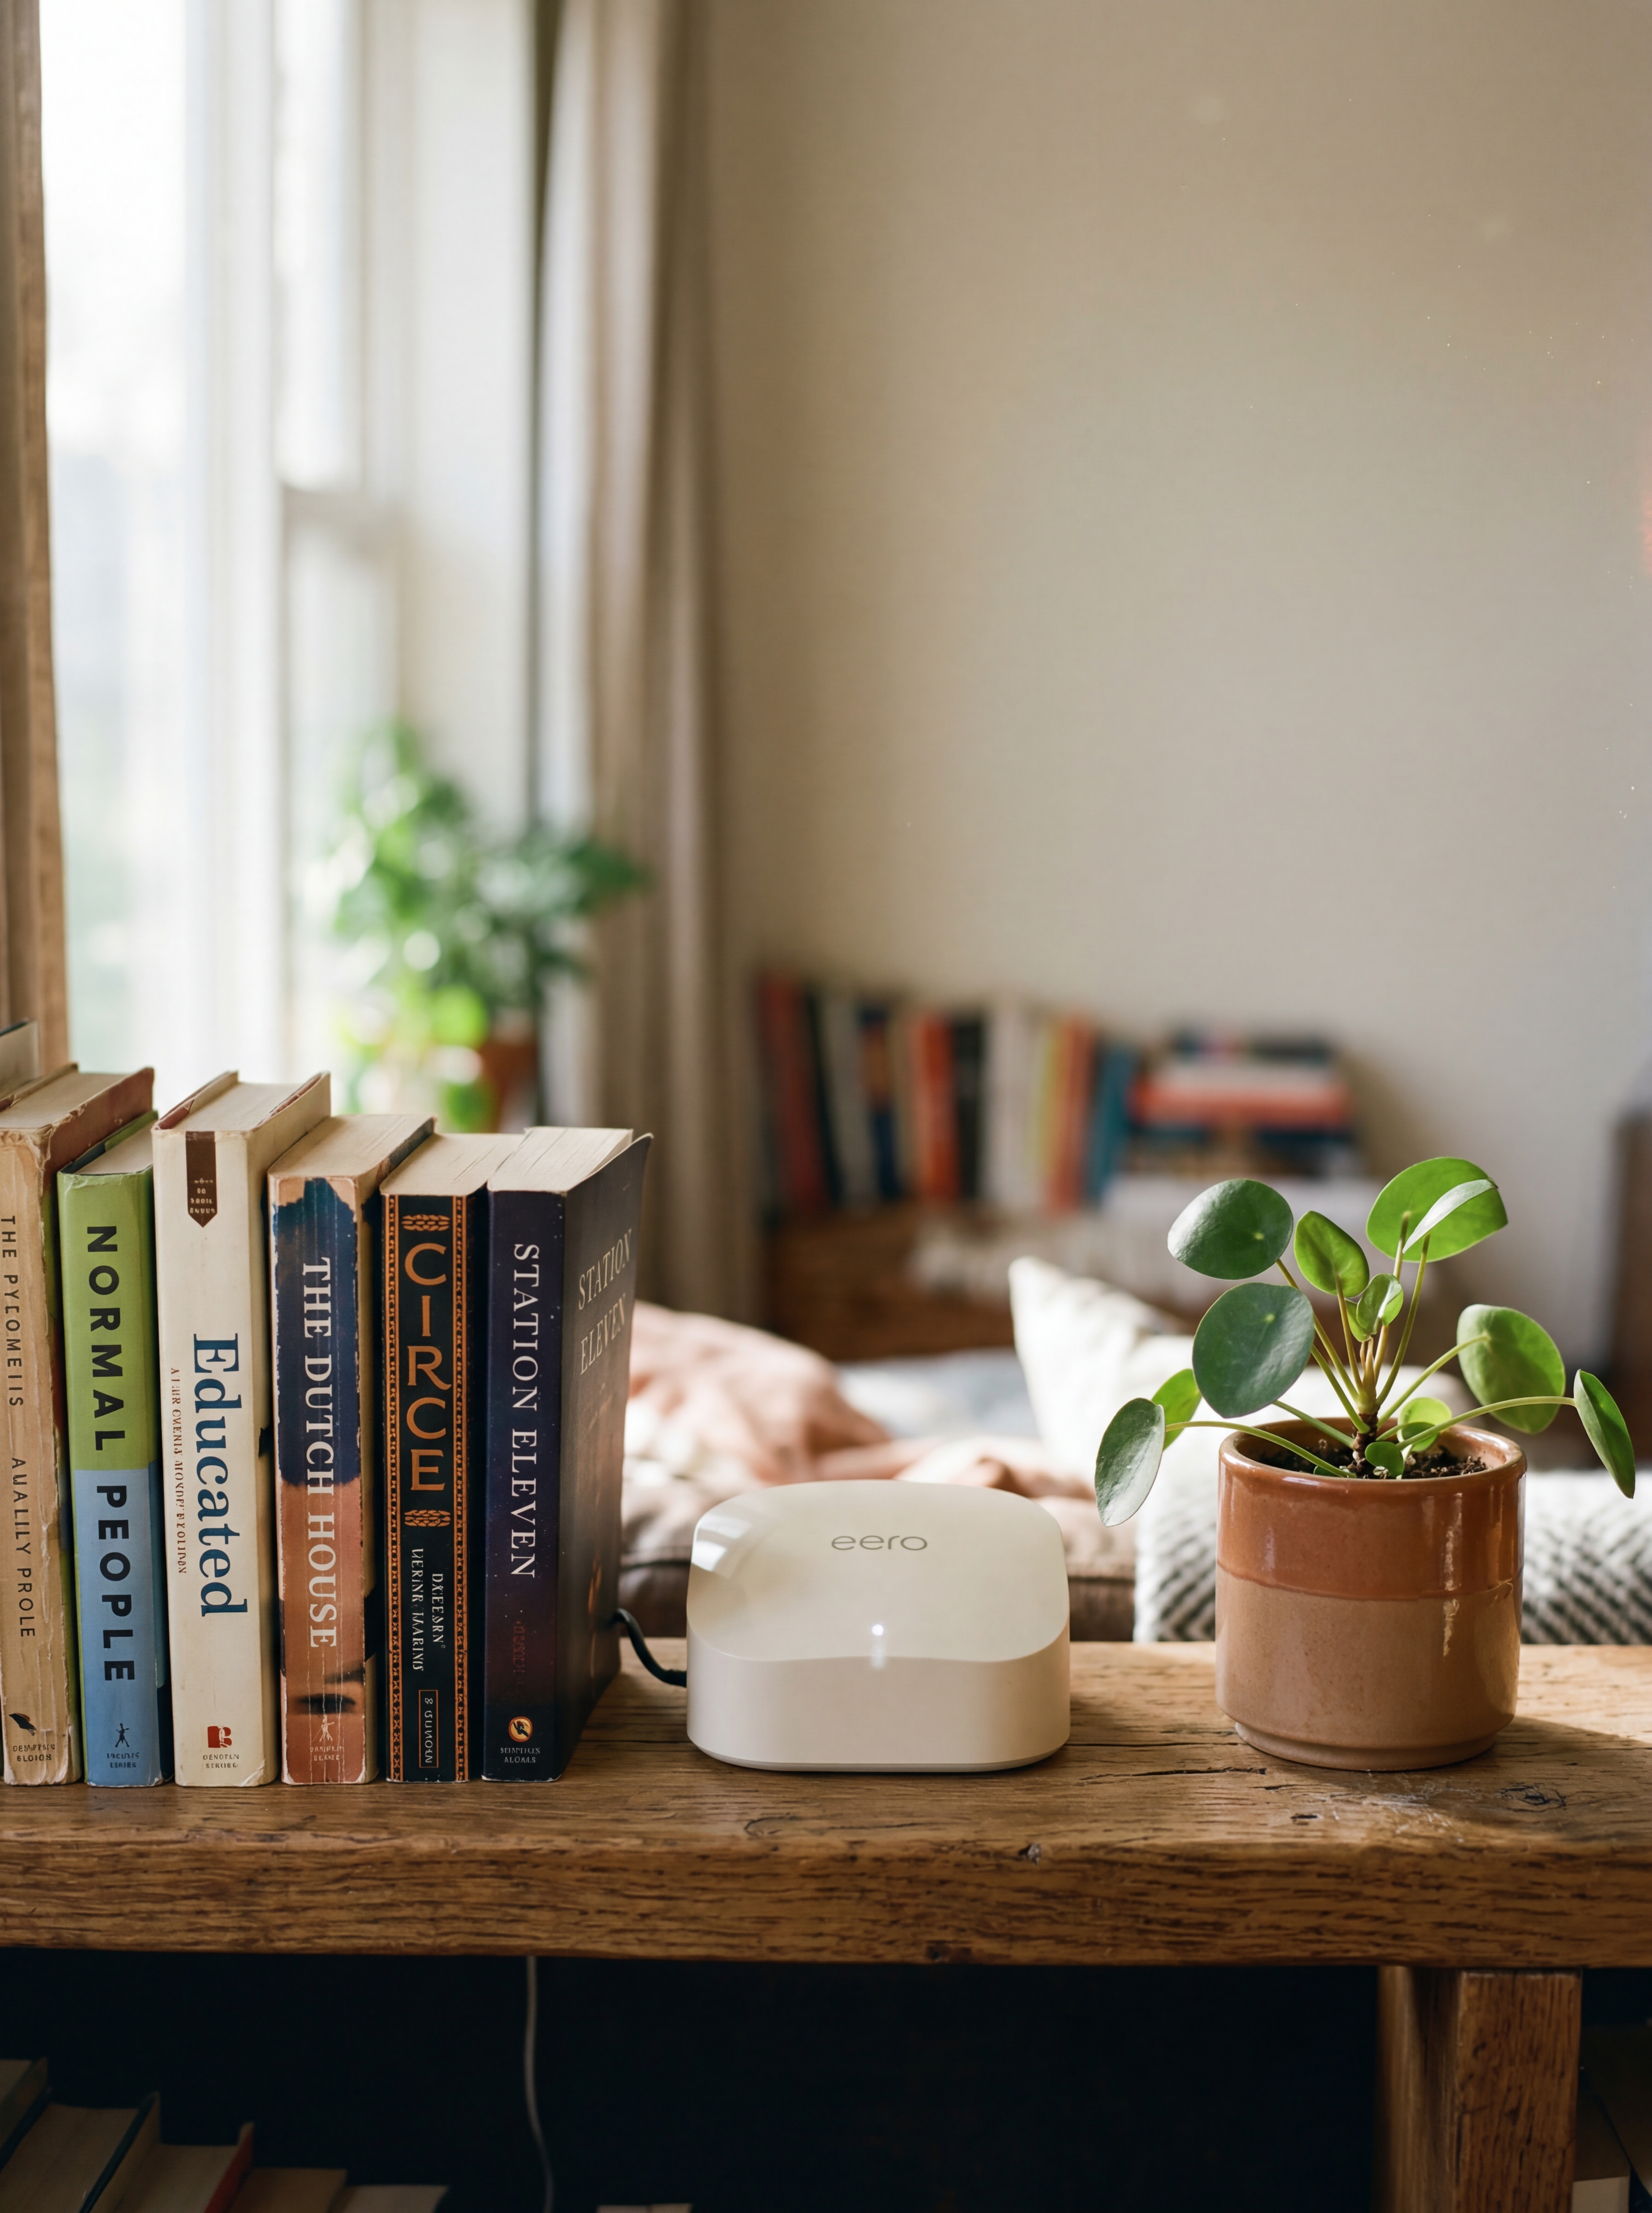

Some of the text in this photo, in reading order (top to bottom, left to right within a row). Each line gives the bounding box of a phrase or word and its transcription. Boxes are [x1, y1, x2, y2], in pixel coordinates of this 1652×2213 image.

[0, 1215, 17, 1258] THE
[578, 1228, 632, 1310] STATION
[404, 1243, 452, 1491] CIRCE
[511, 1243, 539, 1578] STATION ELEVEN
[580, 1292, 626, 1375] ELEVEN
[87, 1225, 135, 1681] NORMAL PEOPLE
[193, 1333, 248, 1617] Educated
[302, 1257, 337, 1647] THE DUTCH HOUSE
[17, 1568, 35, 1637] PROLE
[832, 1535, 927, 1550] eero
